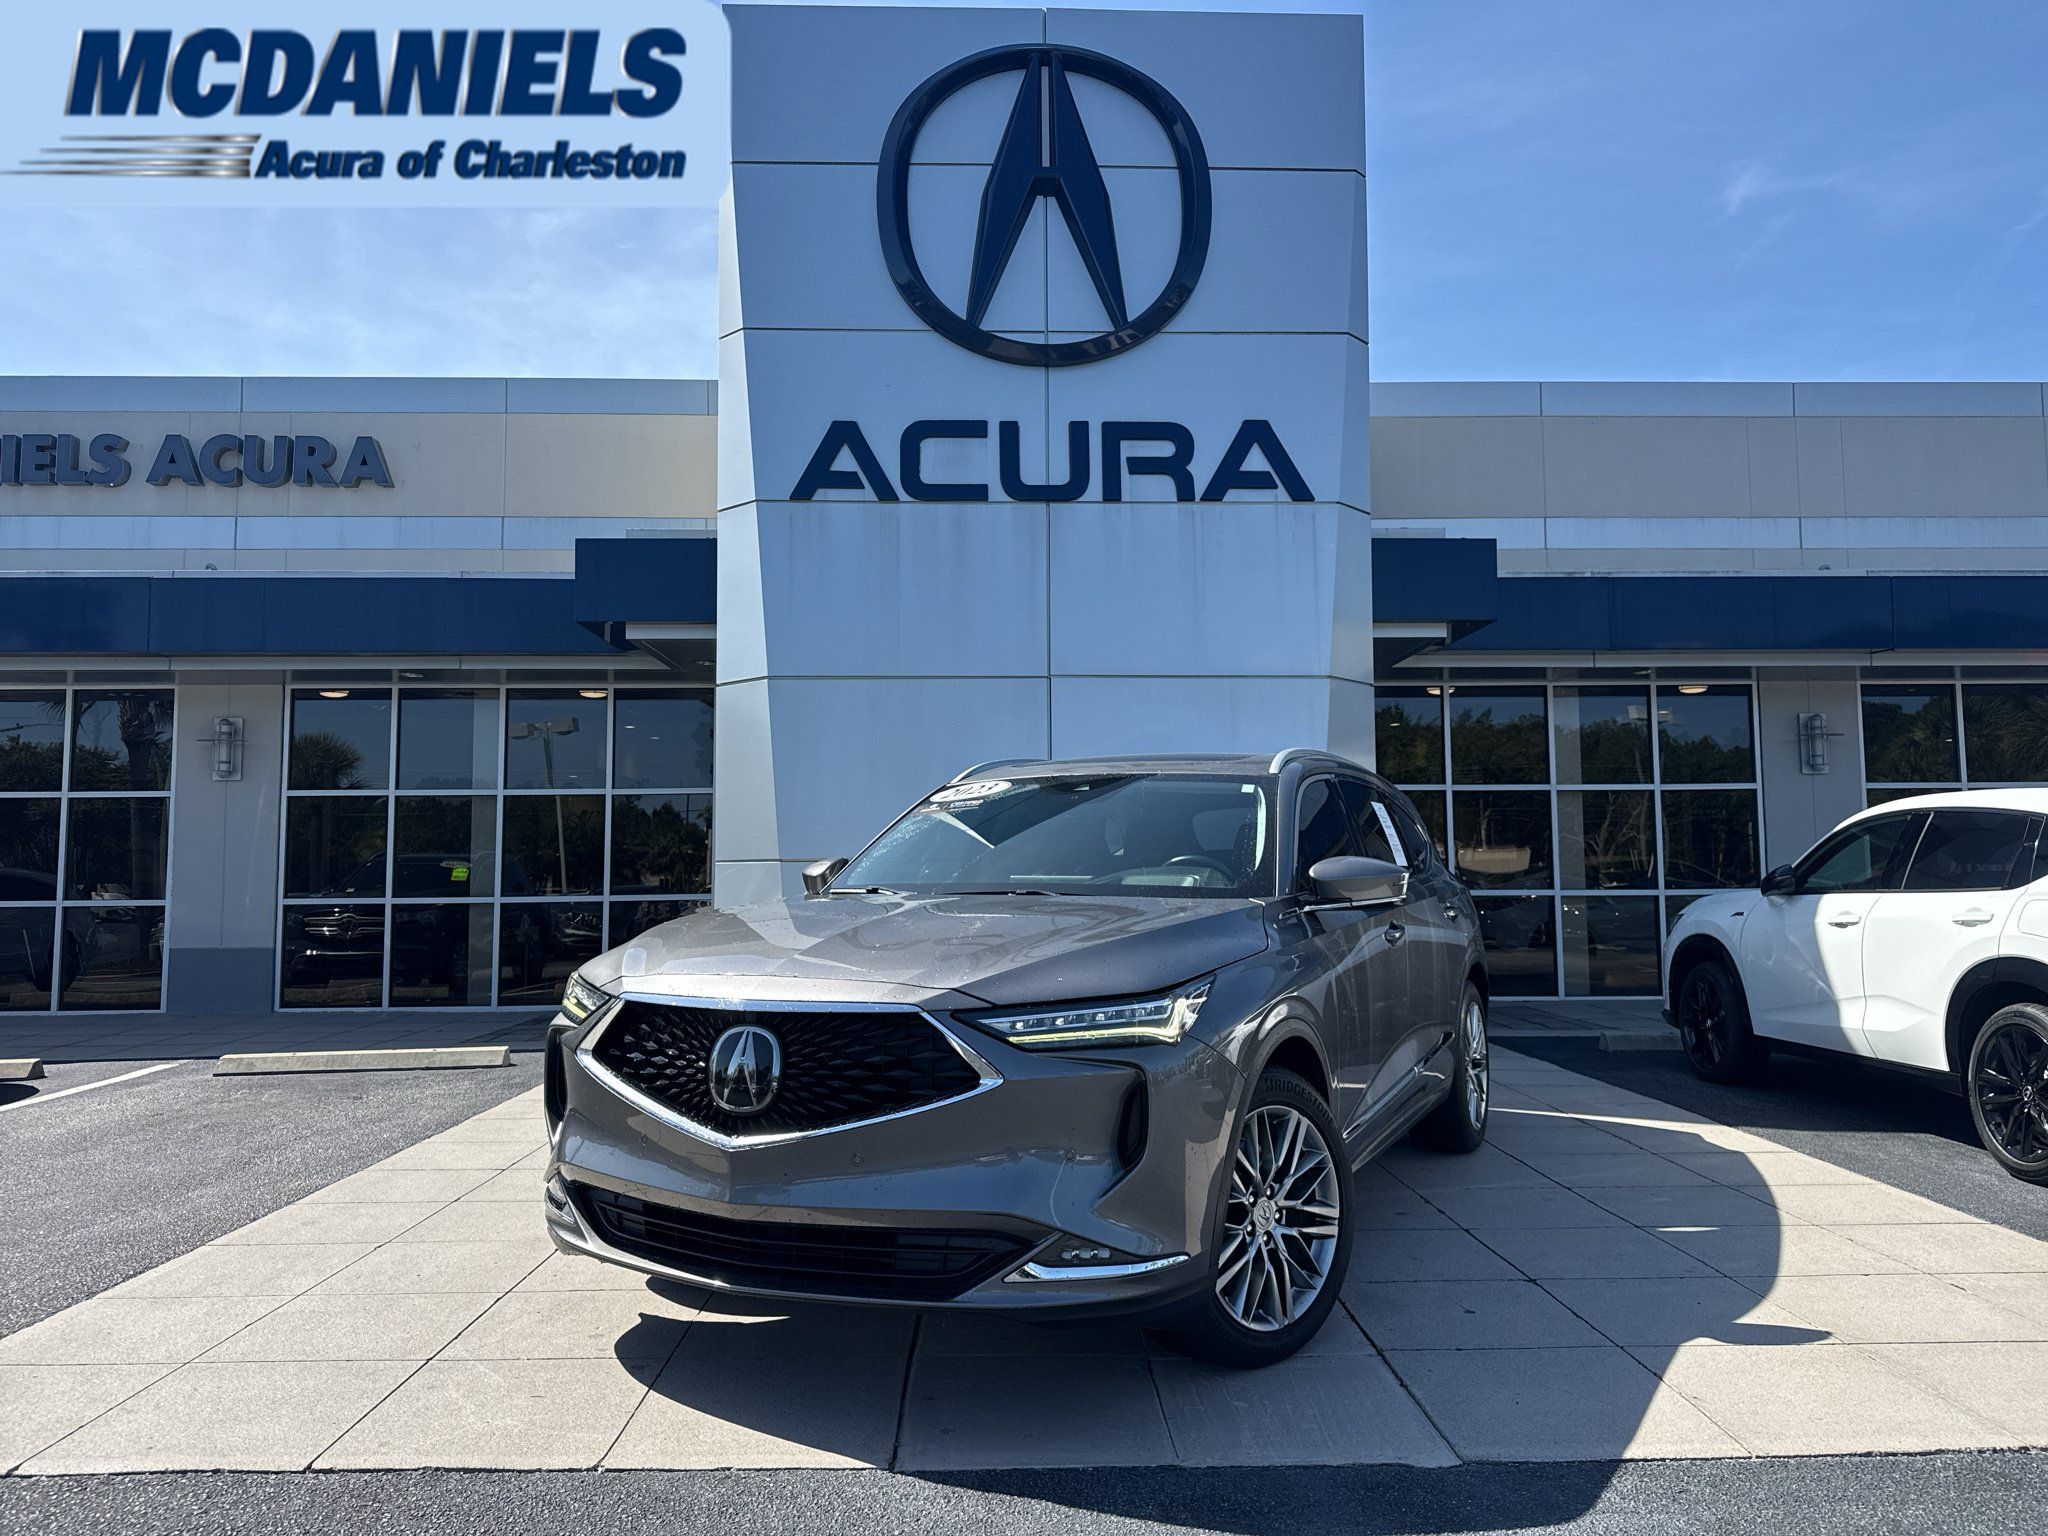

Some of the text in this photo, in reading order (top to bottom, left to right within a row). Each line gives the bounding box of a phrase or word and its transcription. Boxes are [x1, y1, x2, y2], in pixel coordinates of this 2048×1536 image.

[145, 433, 395, 489] ACURA
[789, 419, 1315, 501] ACURA
[938, 782, 1002, 800] 2023
[1264, 1077, 1335, 1129] BRIDGESTONE
